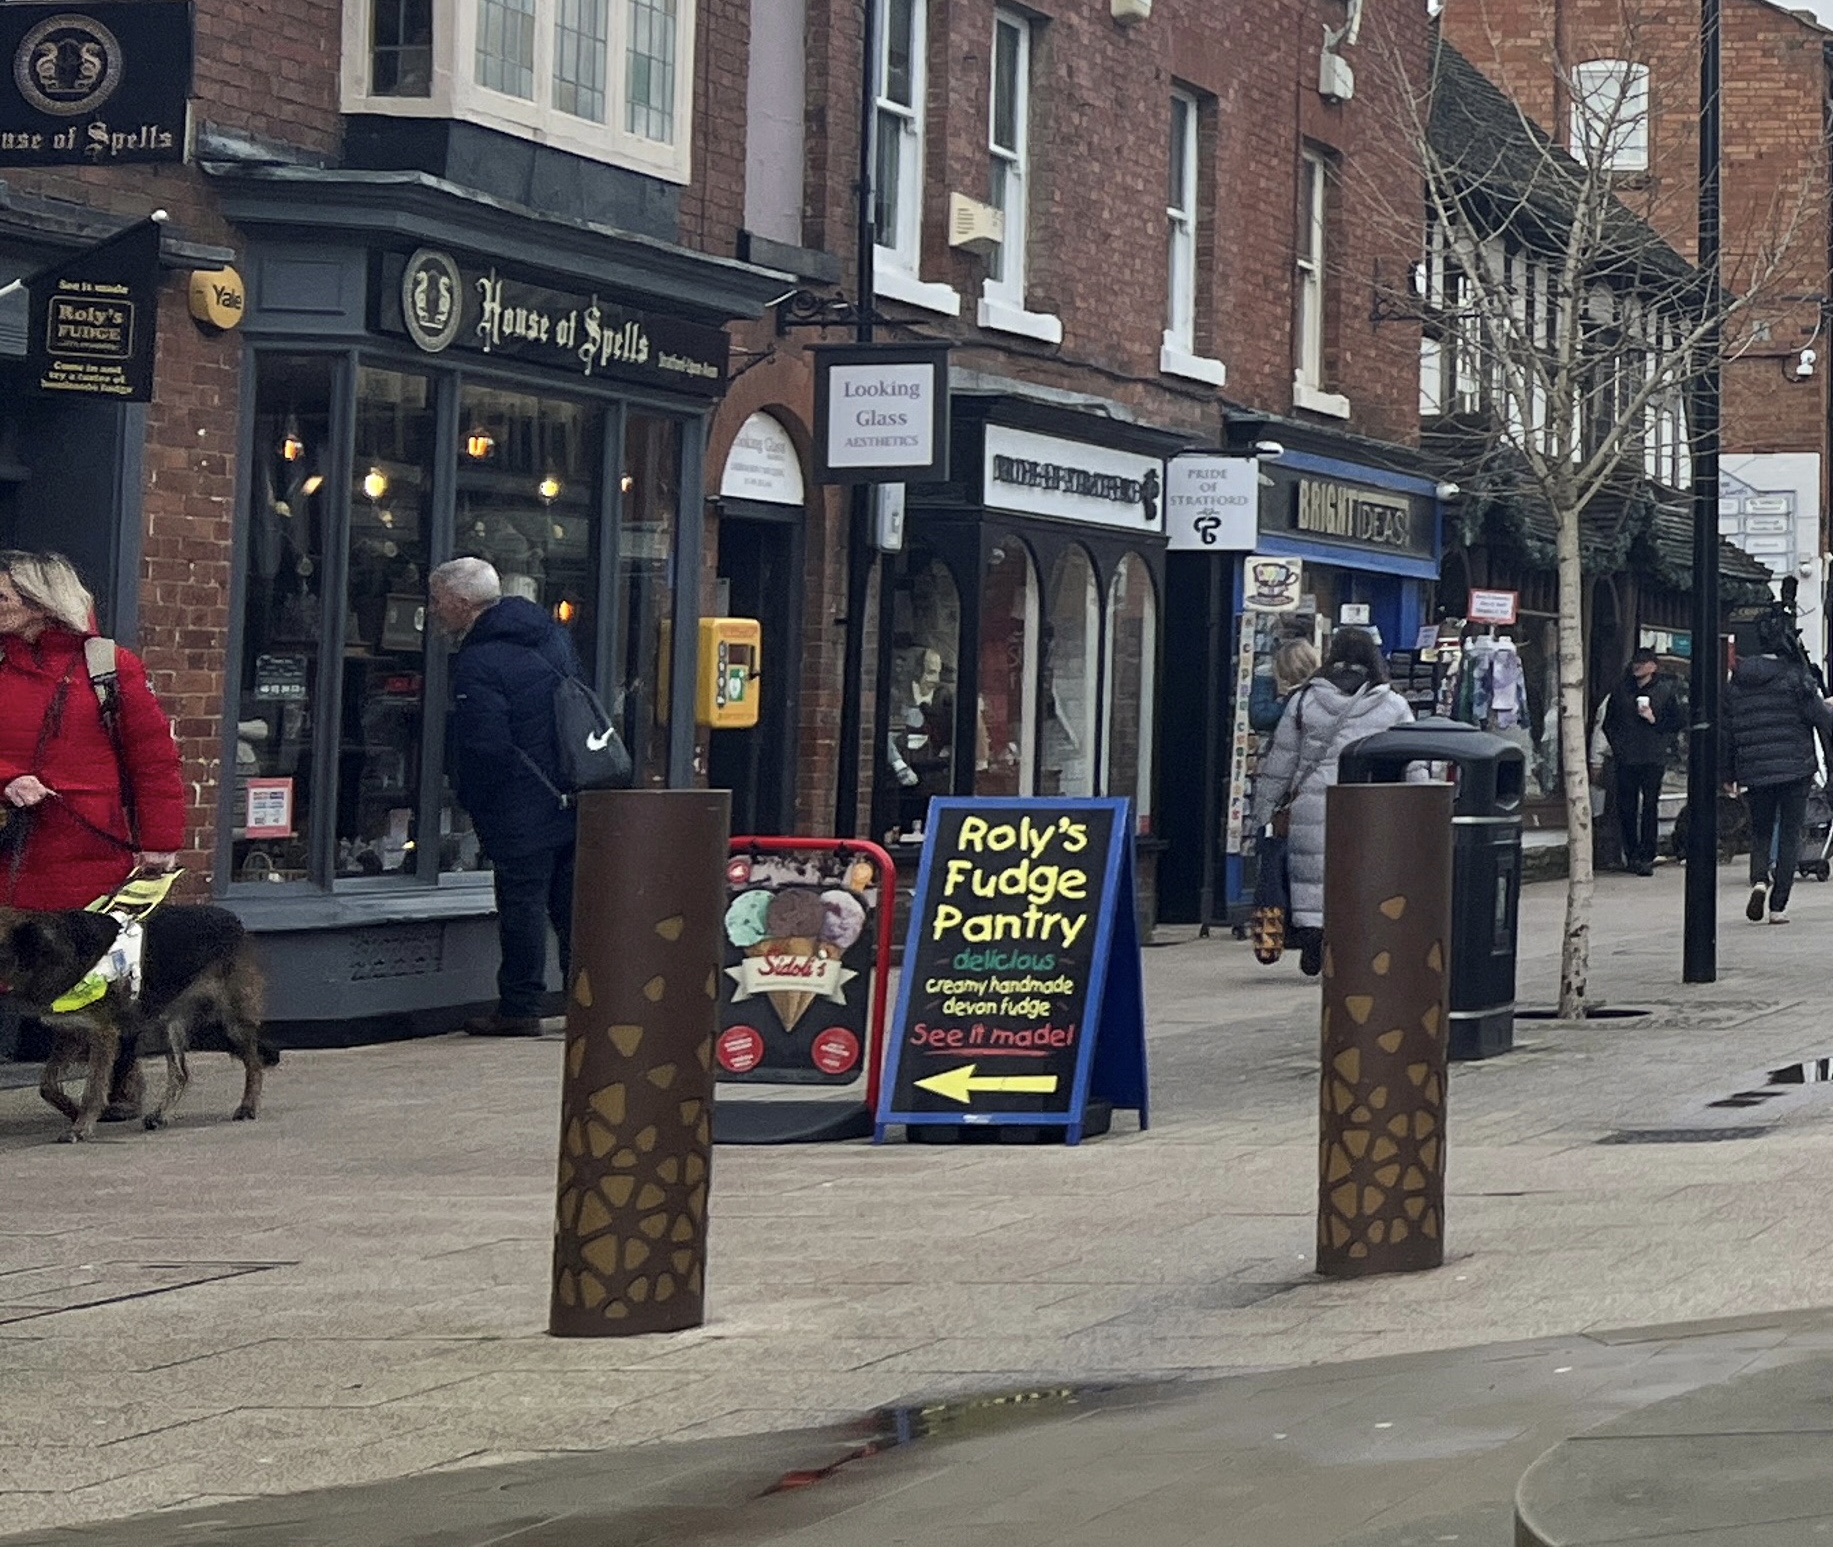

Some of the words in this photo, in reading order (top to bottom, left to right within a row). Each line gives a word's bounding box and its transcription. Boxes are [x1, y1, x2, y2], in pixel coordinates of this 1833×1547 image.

[1, 131, 43, 150] use
[53, 125, 77, 150] of
[85, 121, 173, 158] Spells
[213, 285, 242, 310] Yale
[58, 304, 124, 326] Roly's
[475, 267, 550, 353] House
[556, 309, 578, 348] of
[578, 294, 649, 376] Spells
[58, 324, 121, 341] FUDGE
[844, 380, 921, 400] Looking
[856, 409, 908, 427] Glass
[845, 435, 919, 448] AESTHETICS
[1187, 468, 1228, 480] PRIDE
[1170, 495, 1248, 506] STRATFORD
[1298, 479, 1357, 536] BRIGHT
[958, 816, 1088, 859] Roly's
[944, 858, 1087, 905] Fudge
[933, 903, 1087, 949] Pantry
[953, 947, 1056, 972] delicious
[925, 978, 989, 997] creamy
[989, 974, 1074, 995] handmade
[942, 996, 998, 1016] devon
[1000, 996, 1052, 1020] fudge
[910, 1023, 964, 1047] See
